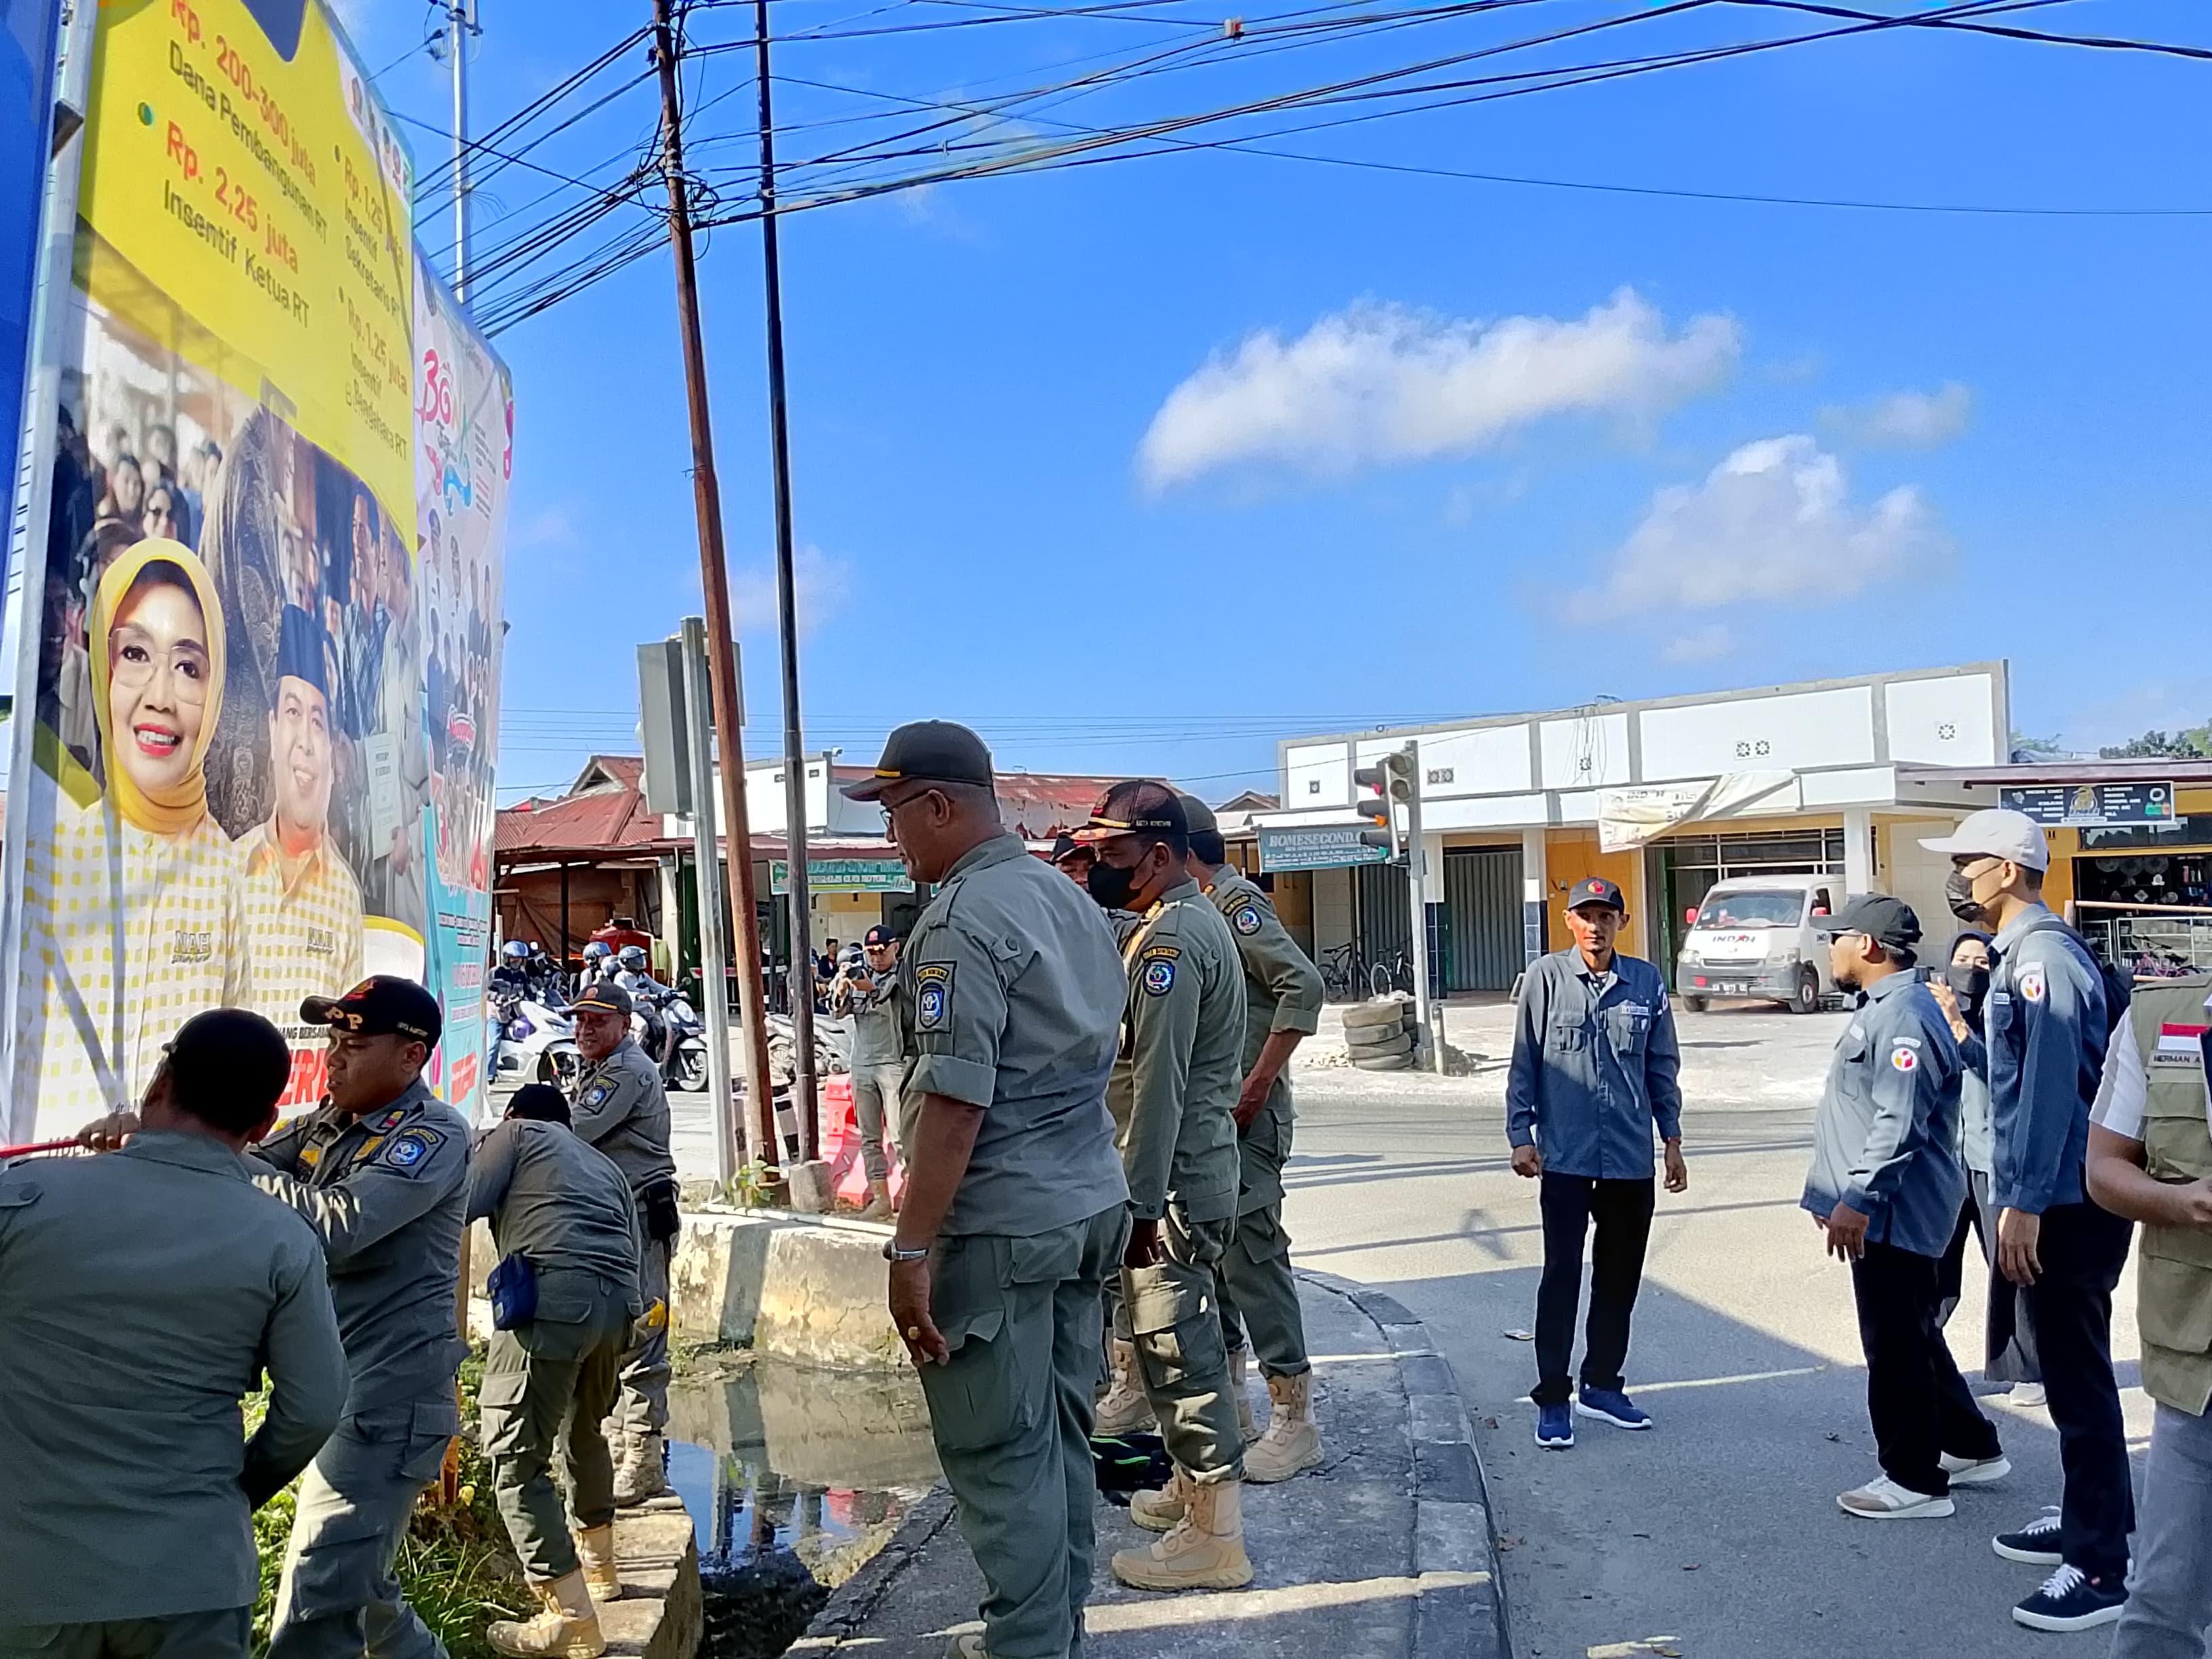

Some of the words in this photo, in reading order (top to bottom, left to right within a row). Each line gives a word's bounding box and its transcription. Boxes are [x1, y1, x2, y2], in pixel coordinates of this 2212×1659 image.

[170, 40, 215, 111] Dana
[220, 91, 314, 228] Pembangunan
[314, 209, 328, 245] RT
[216, 35, 288, 147] 200-300
[291, 127, 315, 188] juta
[167, 119, 203, 184] Rp.
[215, 167, 258, 232] 2,25
[266, 213, 298, 274] juta
[165, 179, 237, 264] Insentif
[245, 247, 290, 310] Ketua
[293, 291, 309, 328] RT
[345, 197, 377, 262] Insentif
[388, 352, 408, 396] juta
[395, 432, 407, 462] RT
[175, 930, 211, 954] NAH
[2154, 1054, 2190, 1063] HERMAN
